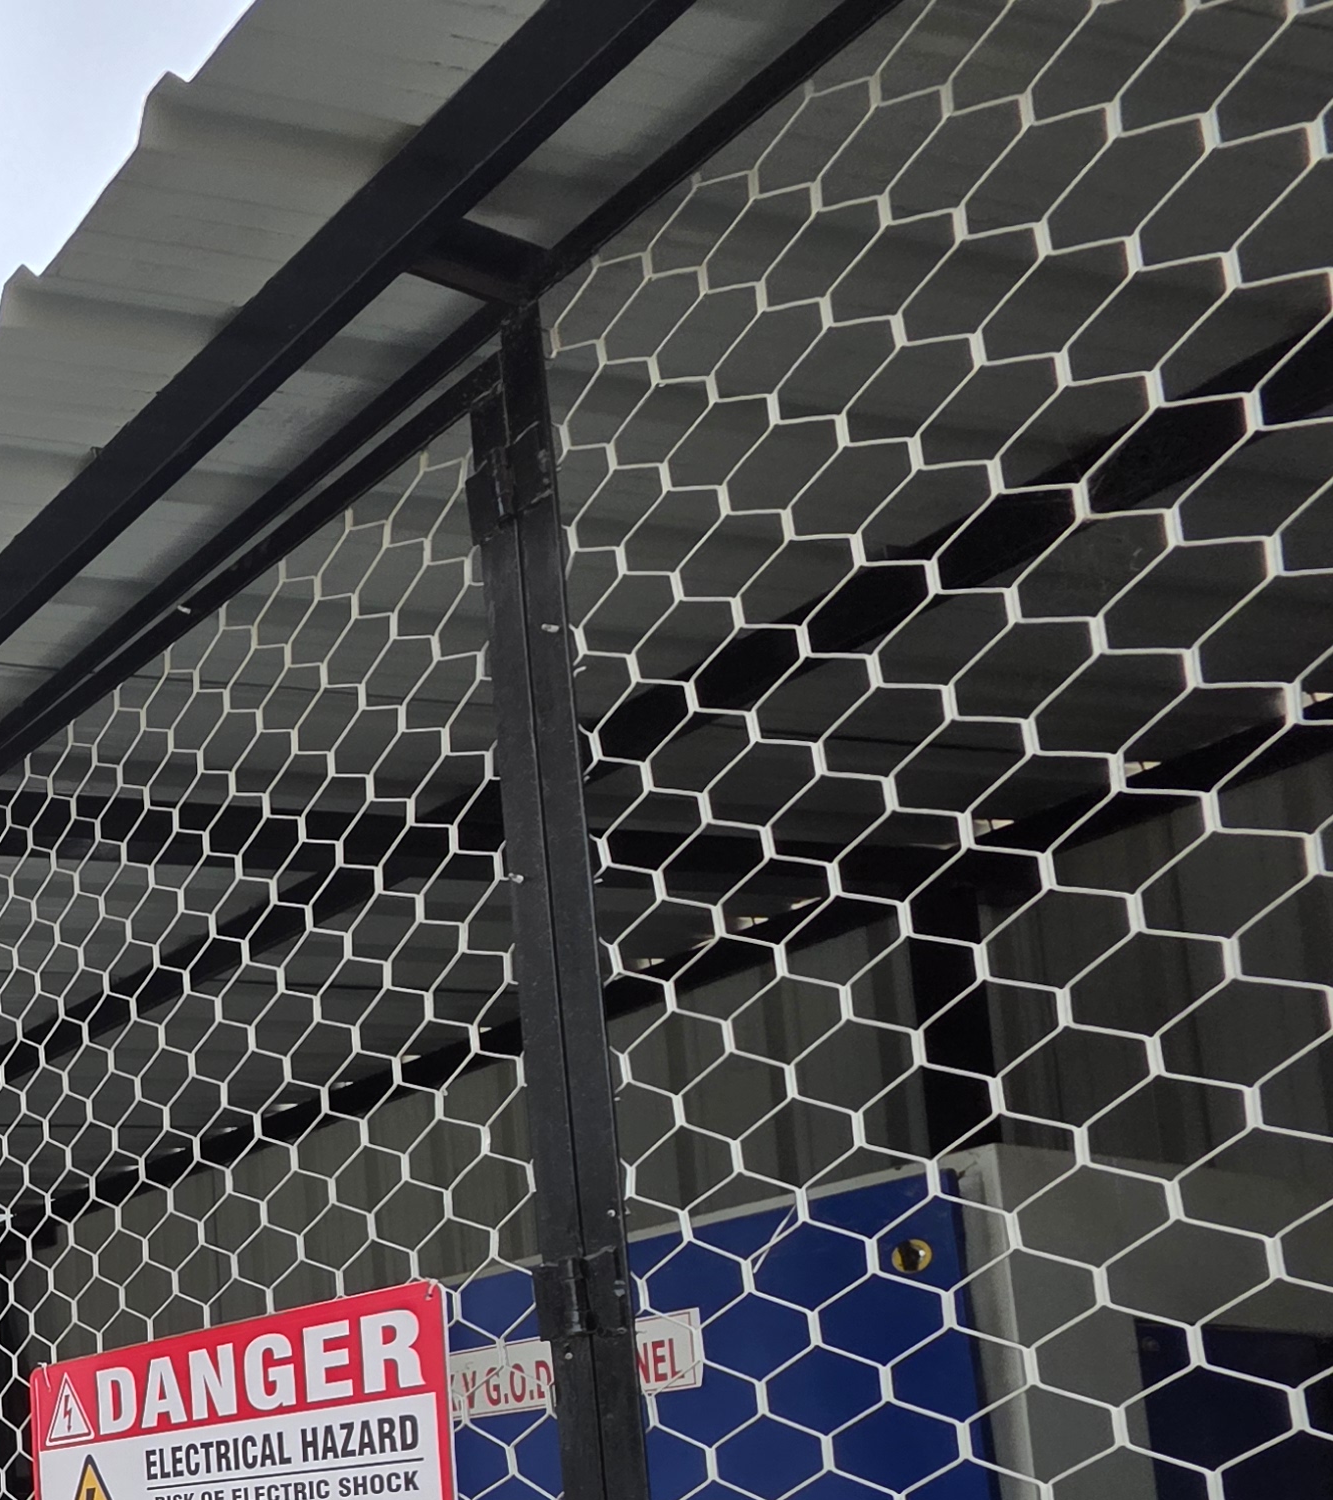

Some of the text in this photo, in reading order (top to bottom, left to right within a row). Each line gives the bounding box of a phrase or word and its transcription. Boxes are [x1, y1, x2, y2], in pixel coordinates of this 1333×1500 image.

[95, 1309, 425, 1435] DANGER
[145, 1414, 418, 1480] ELECTRICAL HAZARD
[338, 1470, 419, 1497] SHOCK
